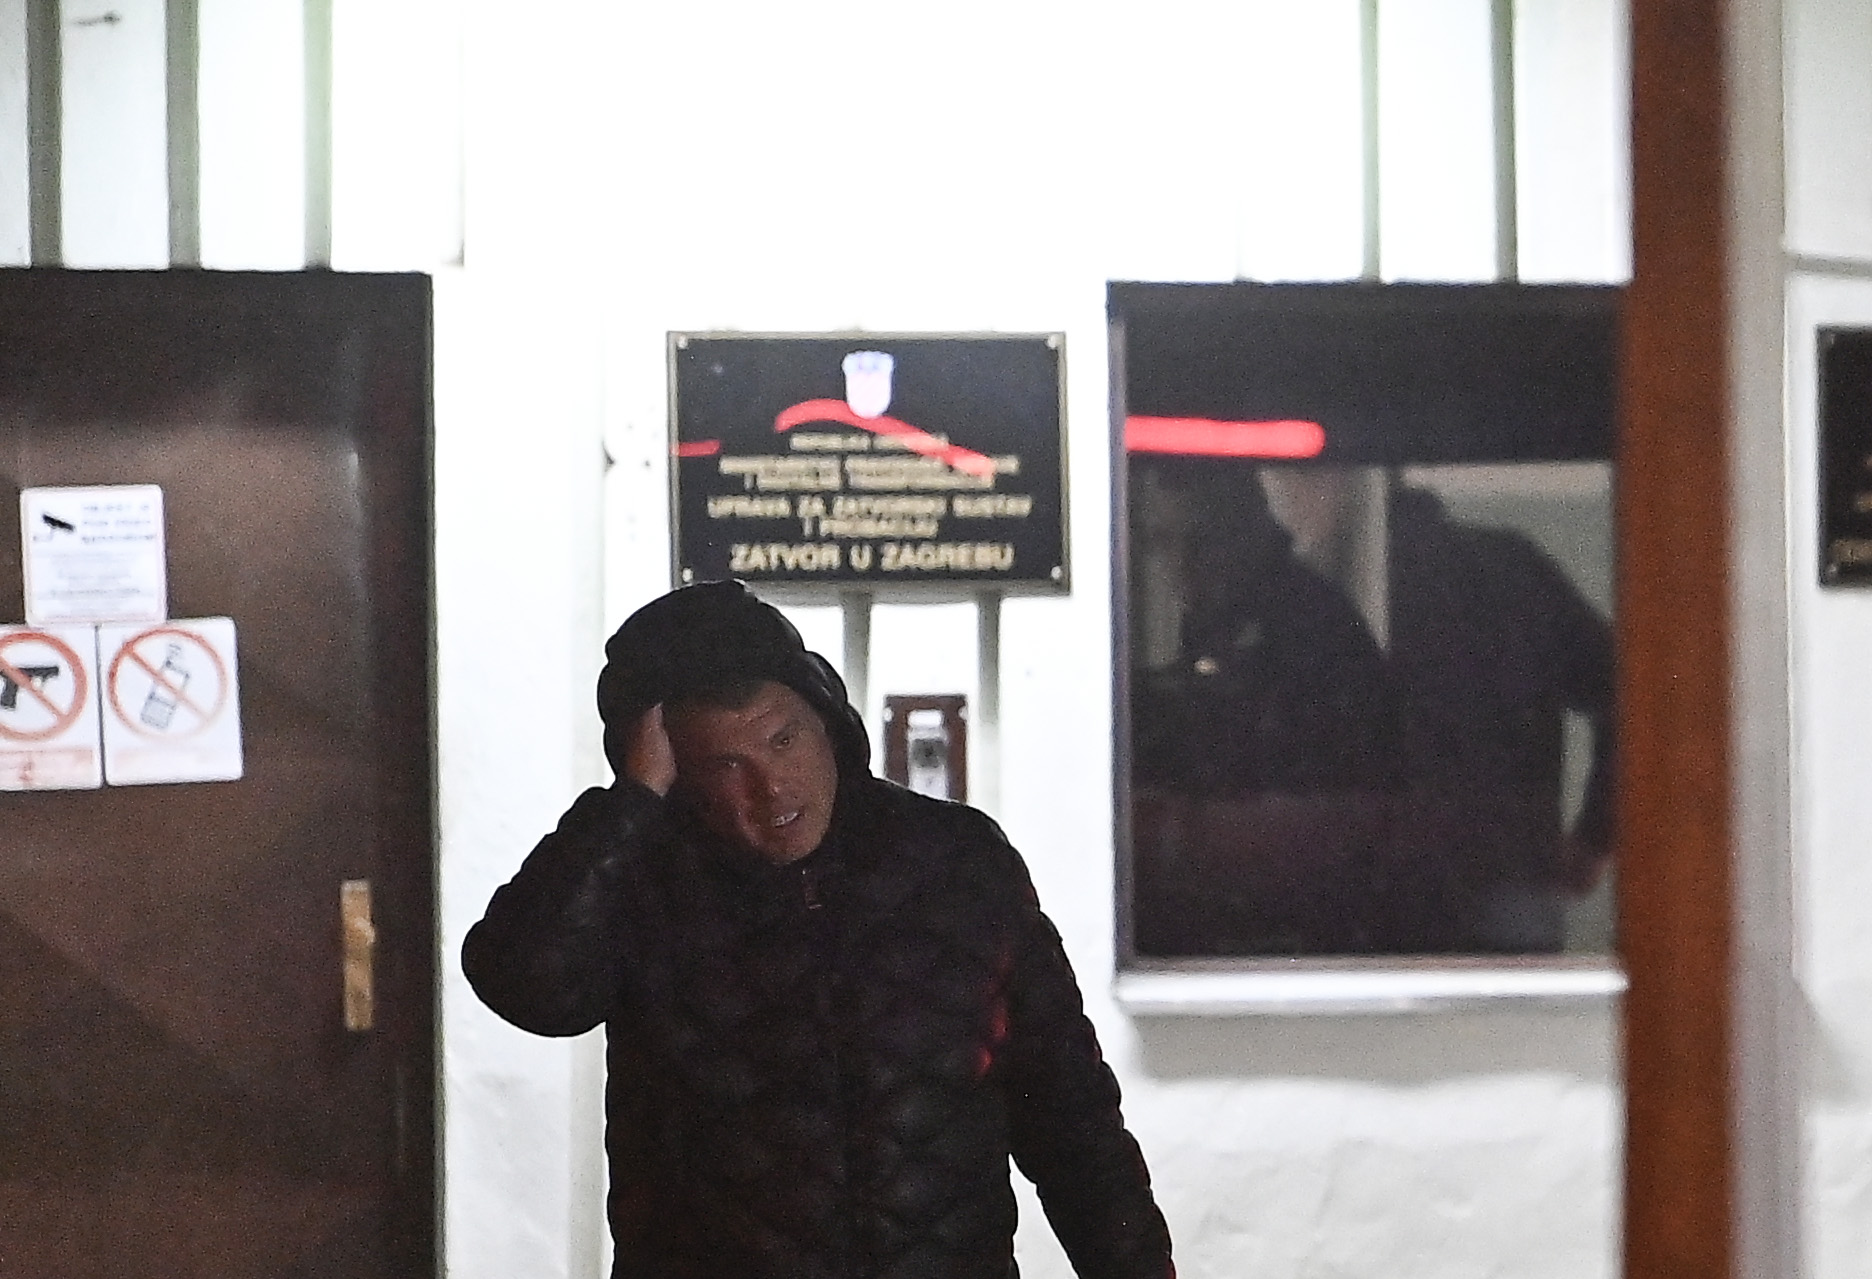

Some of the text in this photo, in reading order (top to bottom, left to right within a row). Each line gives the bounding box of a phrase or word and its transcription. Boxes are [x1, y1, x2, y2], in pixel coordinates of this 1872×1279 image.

[729, 542, 1015, 571] ZATVOR U ZAGREBU
